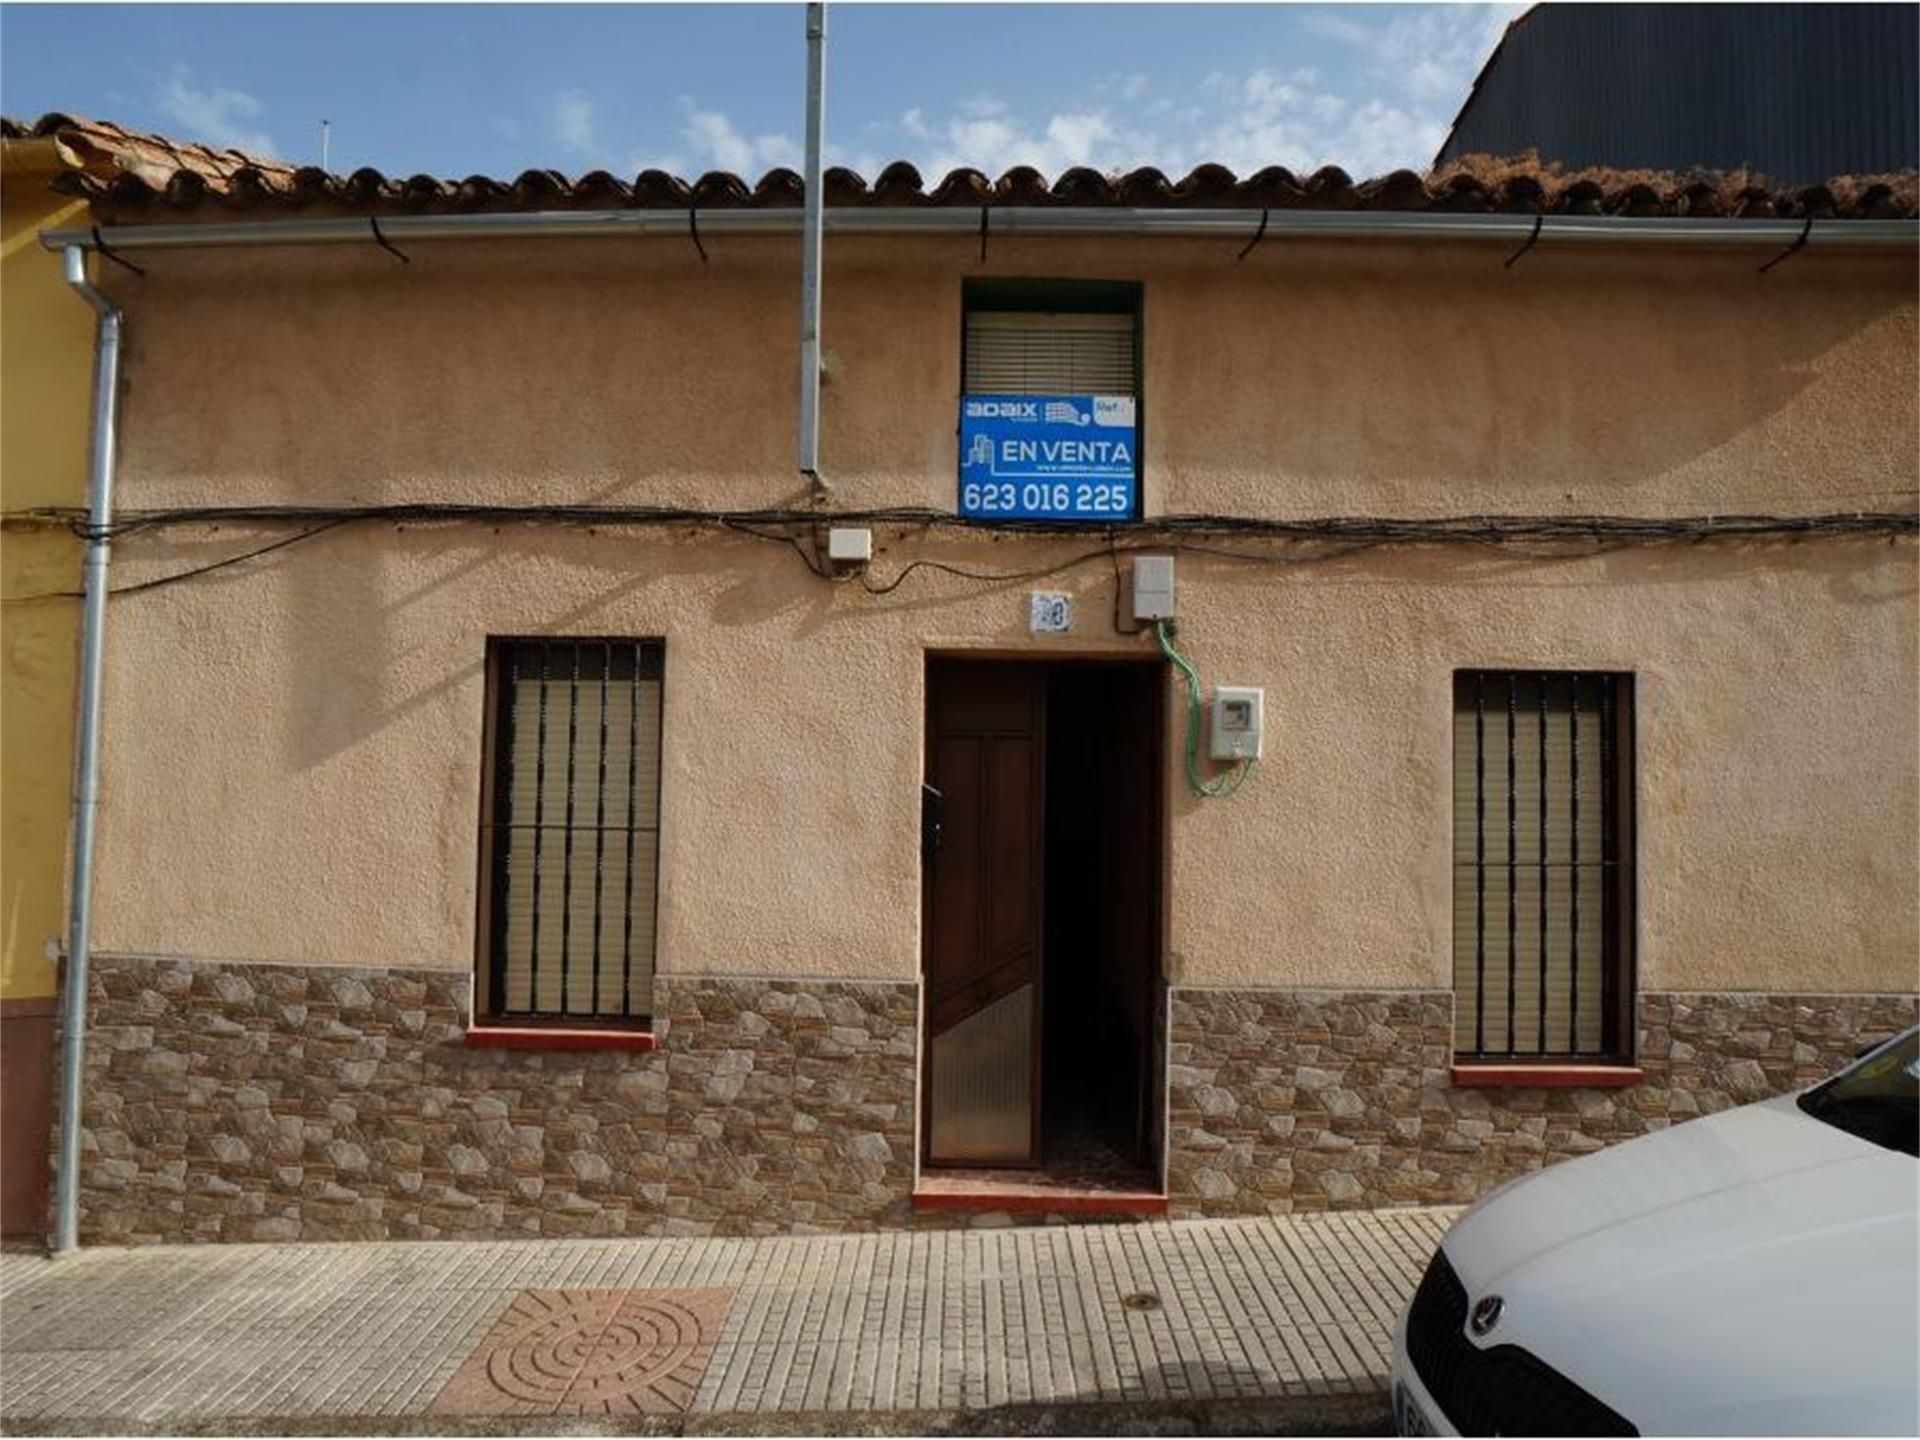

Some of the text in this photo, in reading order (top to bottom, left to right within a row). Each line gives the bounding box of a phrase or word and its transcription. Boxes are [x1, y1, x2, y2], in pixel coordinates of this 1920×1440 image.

[1002, 440, 1131, 463] EN VENTA
[964, 483, 1128, 512] 623 016 225
